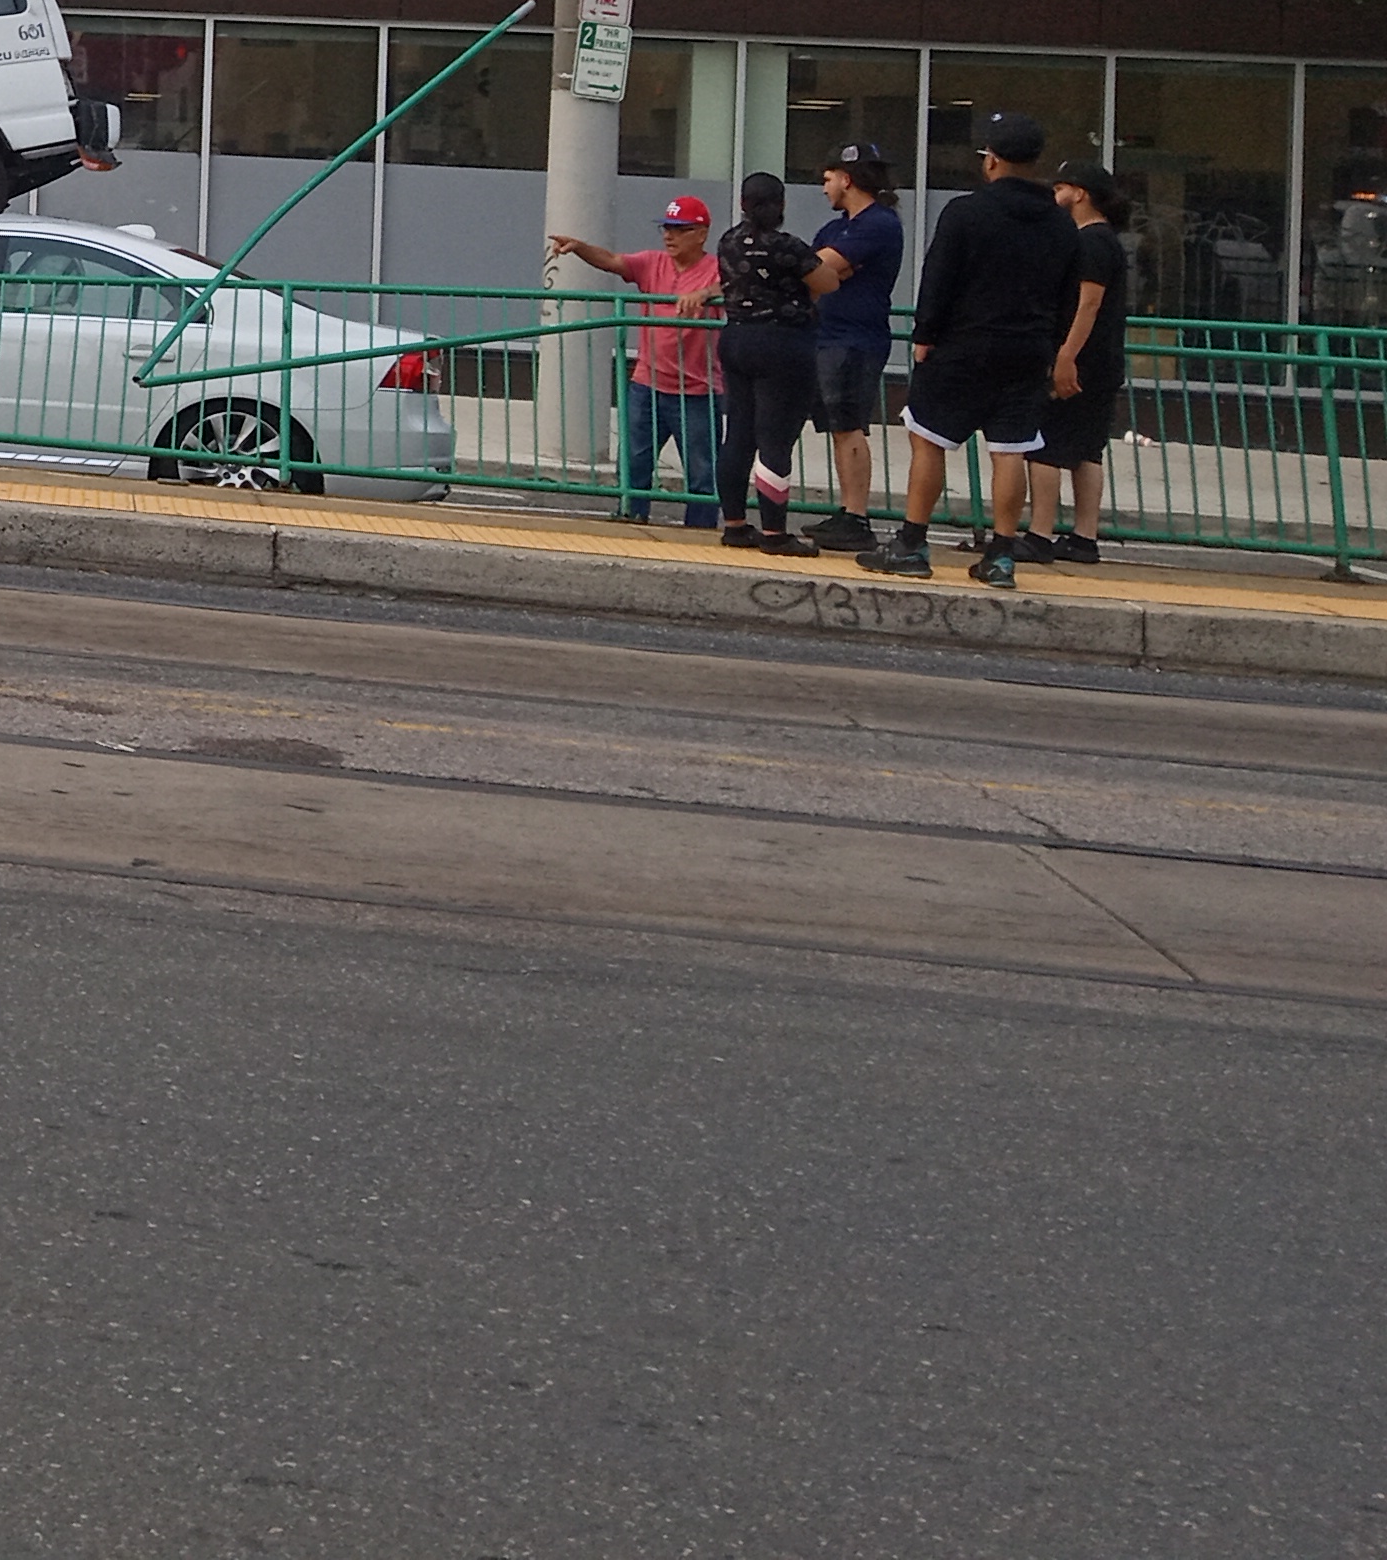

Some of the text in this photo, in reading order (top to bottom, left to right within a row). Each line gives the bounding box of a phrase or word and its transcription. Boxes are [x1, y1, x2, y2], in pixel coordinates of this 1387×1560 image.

[18, 22, 46, 41] 601
[582, 26, 593, 46] 2
[595, 38, 628, 52] PARKING
